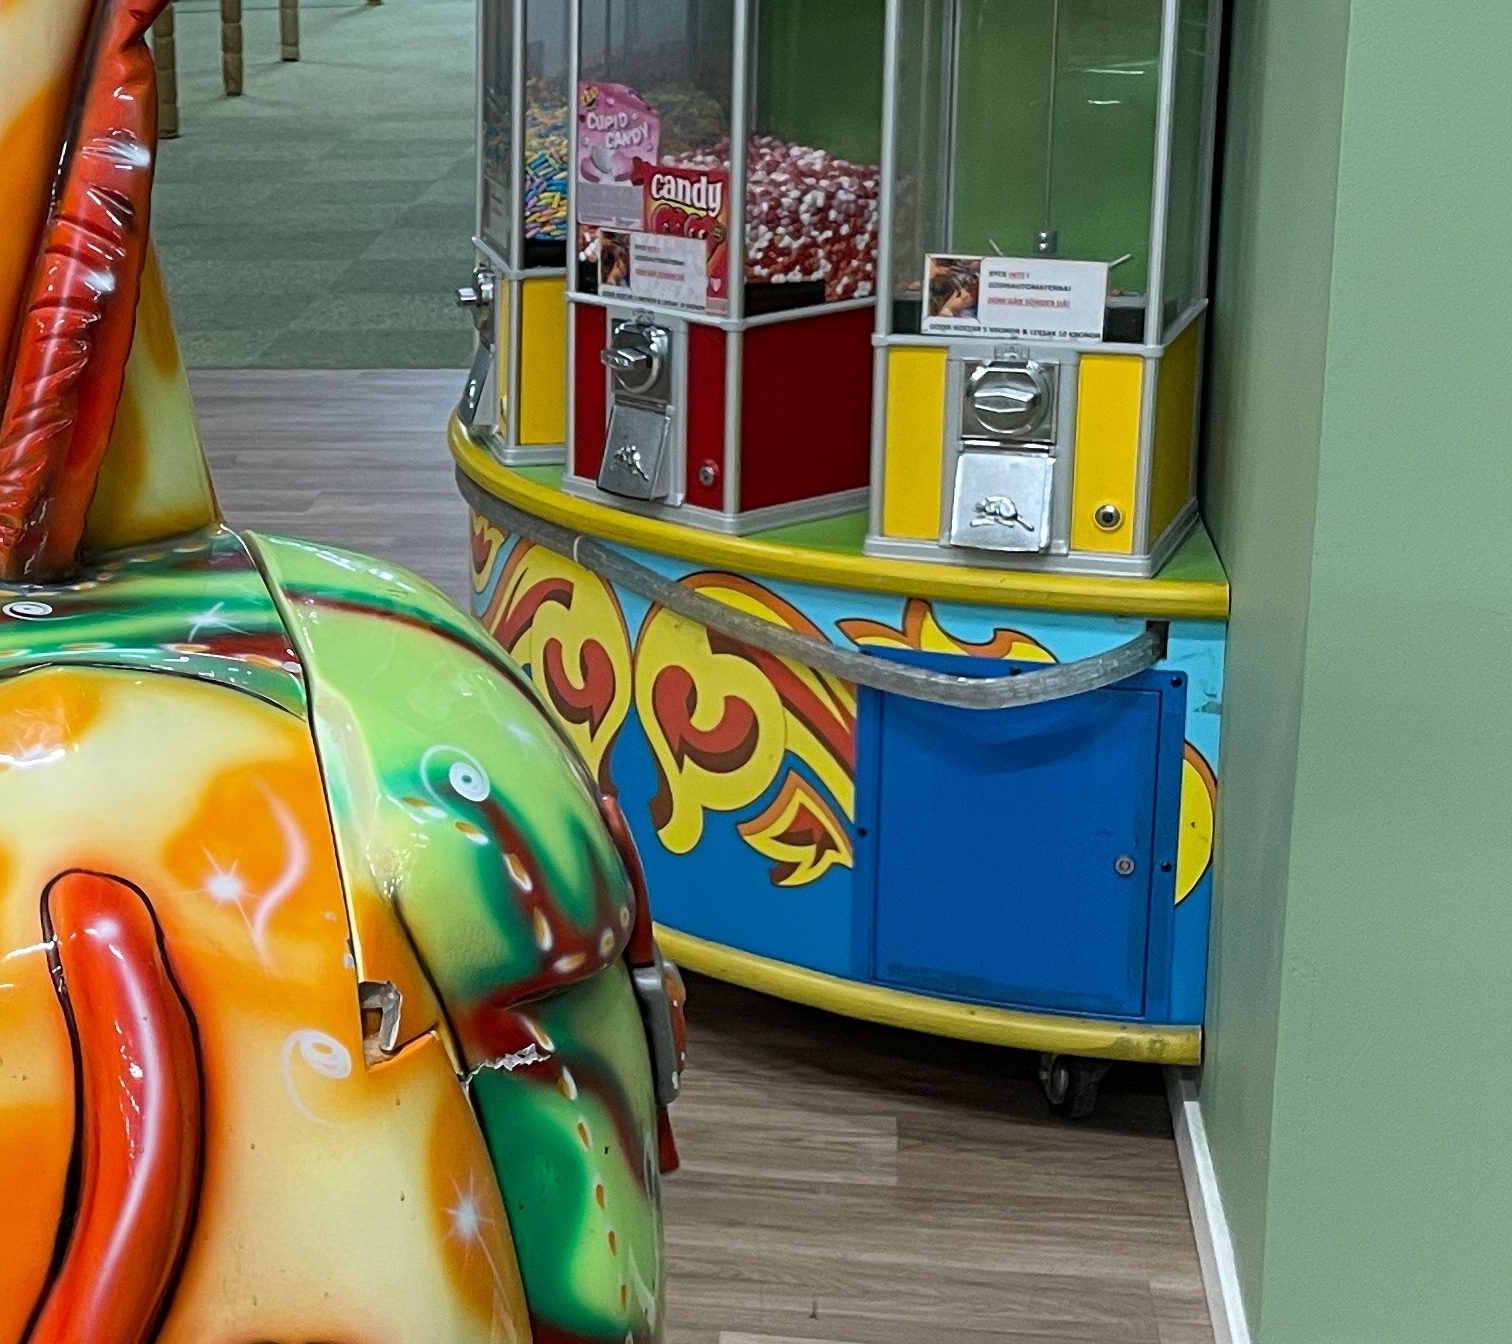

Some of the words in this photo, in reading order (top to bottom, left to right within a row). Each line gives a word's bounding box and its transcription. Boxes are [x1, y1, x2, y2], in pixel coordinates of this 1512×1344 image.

[587, 112, 628, 130] CUPID
[605, 122, 648, 148] CANDY
[651, 174, 723, 218] candy
